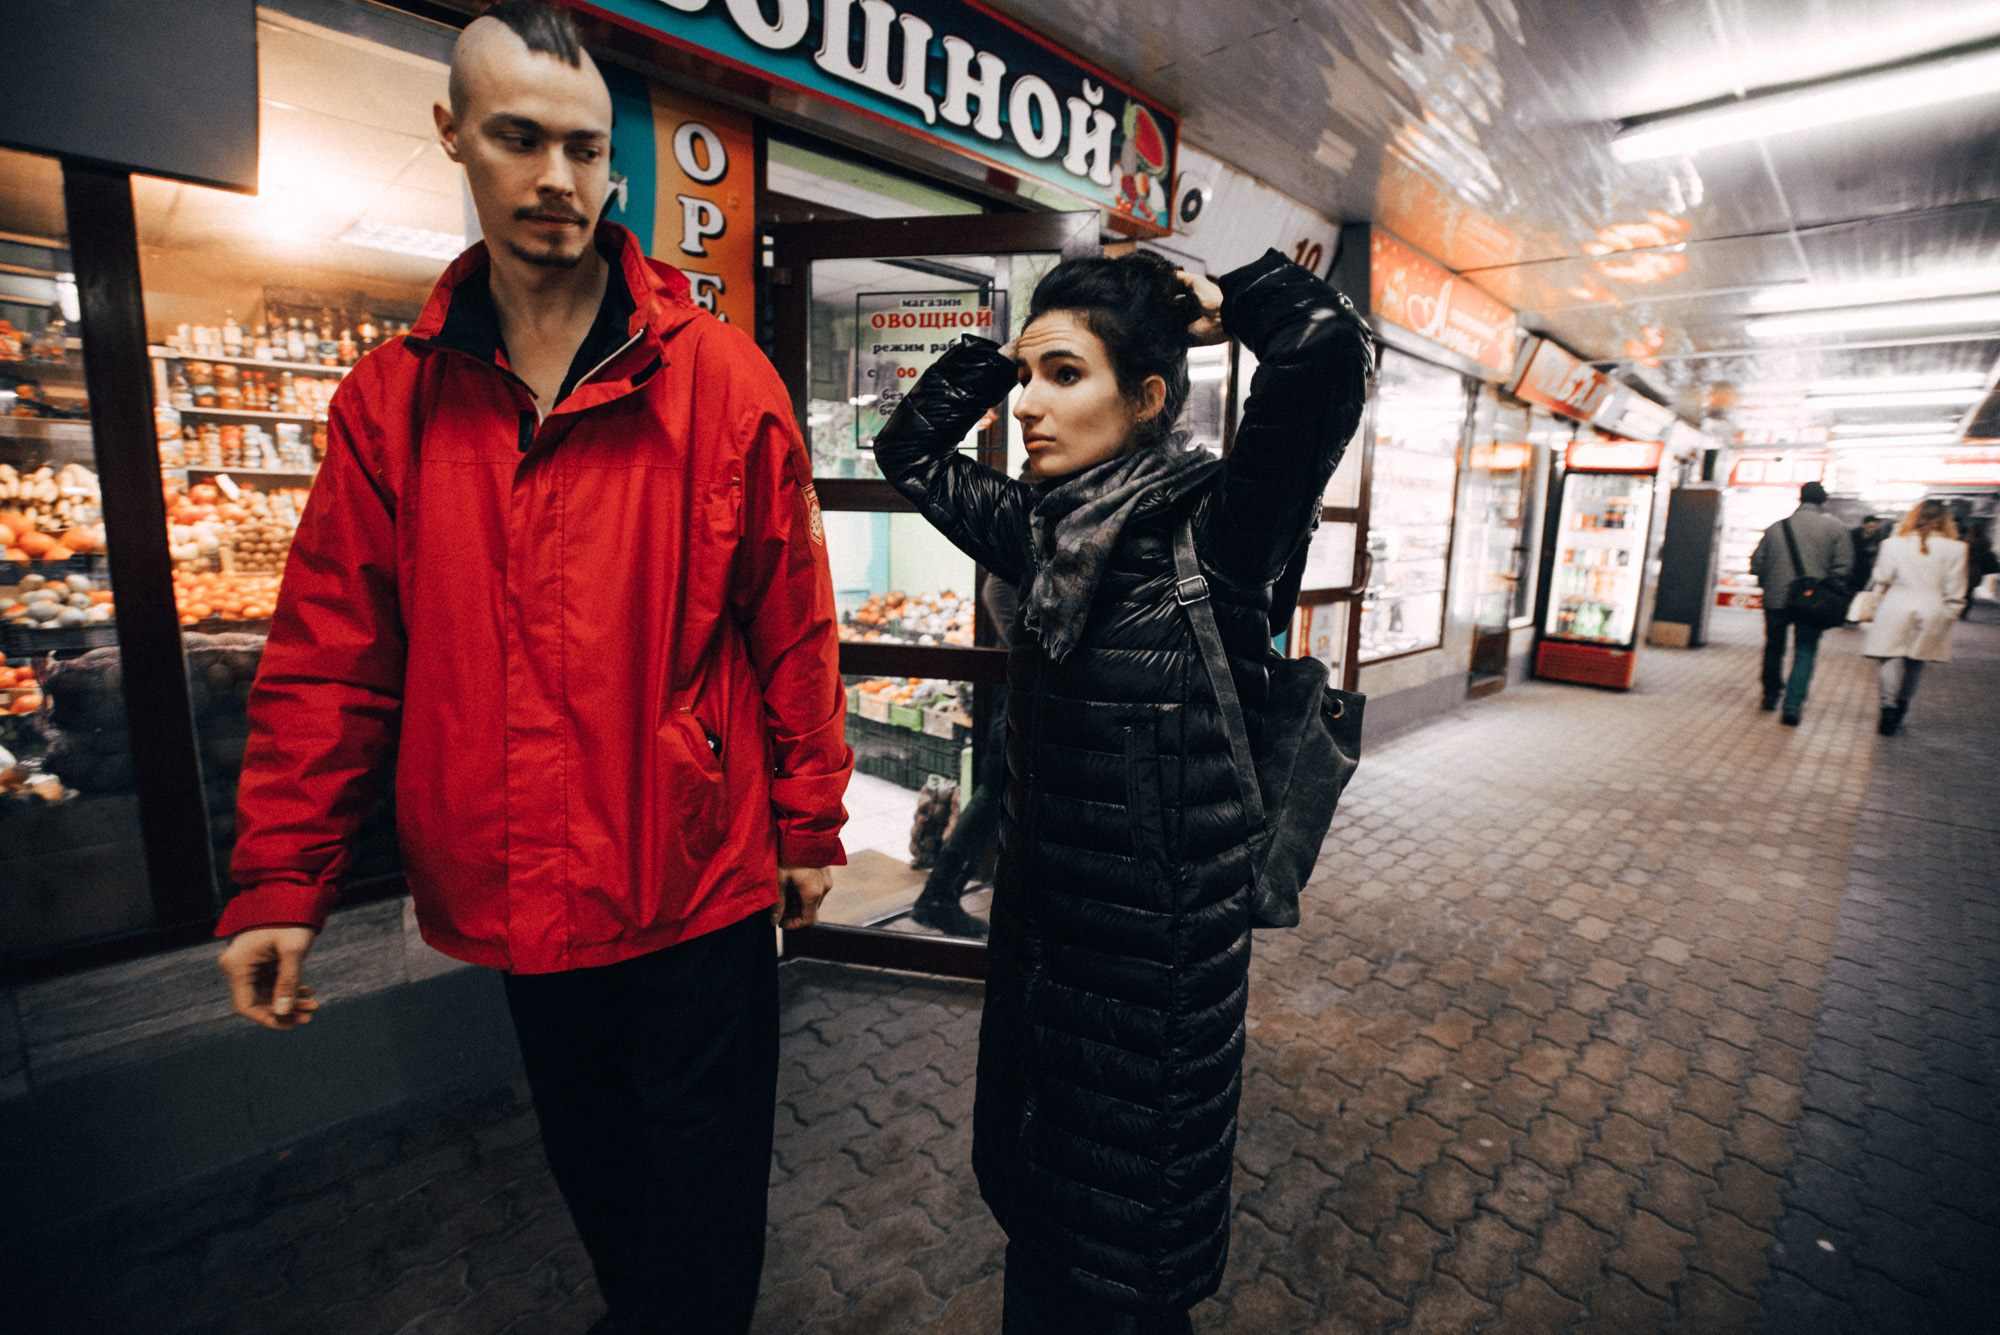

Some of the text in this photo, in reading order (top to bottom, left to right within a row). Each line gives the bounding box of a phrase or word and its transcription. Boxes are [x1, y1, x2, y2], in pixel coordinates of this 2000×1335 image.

[652, 0, 1117, 187] ЩНОЙ
[902, 298, 962, 307] магазин
[871, 305, 992, 330] ОВОЩНОЙ
[873, 343, 924, 354] режим
